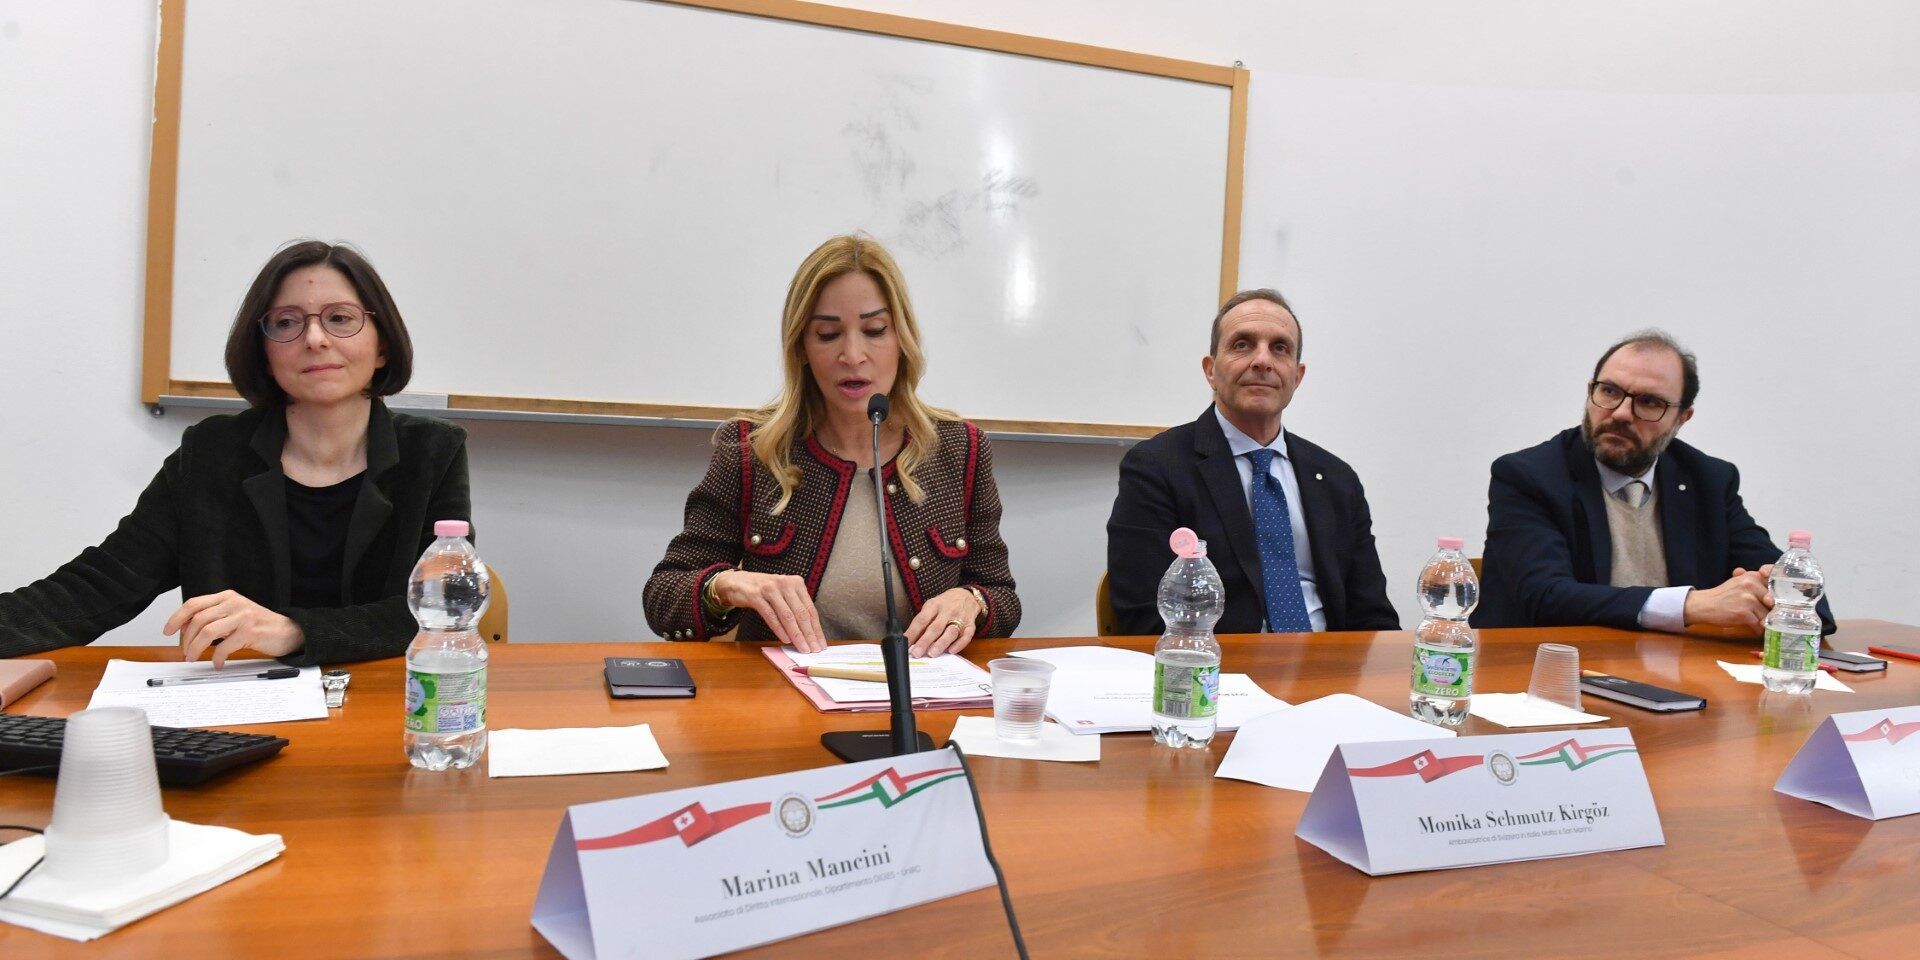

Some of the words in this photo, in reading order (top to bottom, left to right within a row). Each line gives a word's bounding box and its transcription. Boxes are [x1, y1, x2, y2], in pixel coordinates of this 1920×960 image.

[1435, 688, 1458, 696] ZERO
[1418, 814, 1482, 834] Monika
[1486, 810, 1556, 829] Schmutz
[1558, 802, 1610, 824] Kirgöz
[720, 869, 800, 899] Marina
[806, 844, 892, 881] Mancini
[694, 908, 735, 924] Associato
[736, 906, 744, 914] di
[744, 901, 769, 912] Diritto
